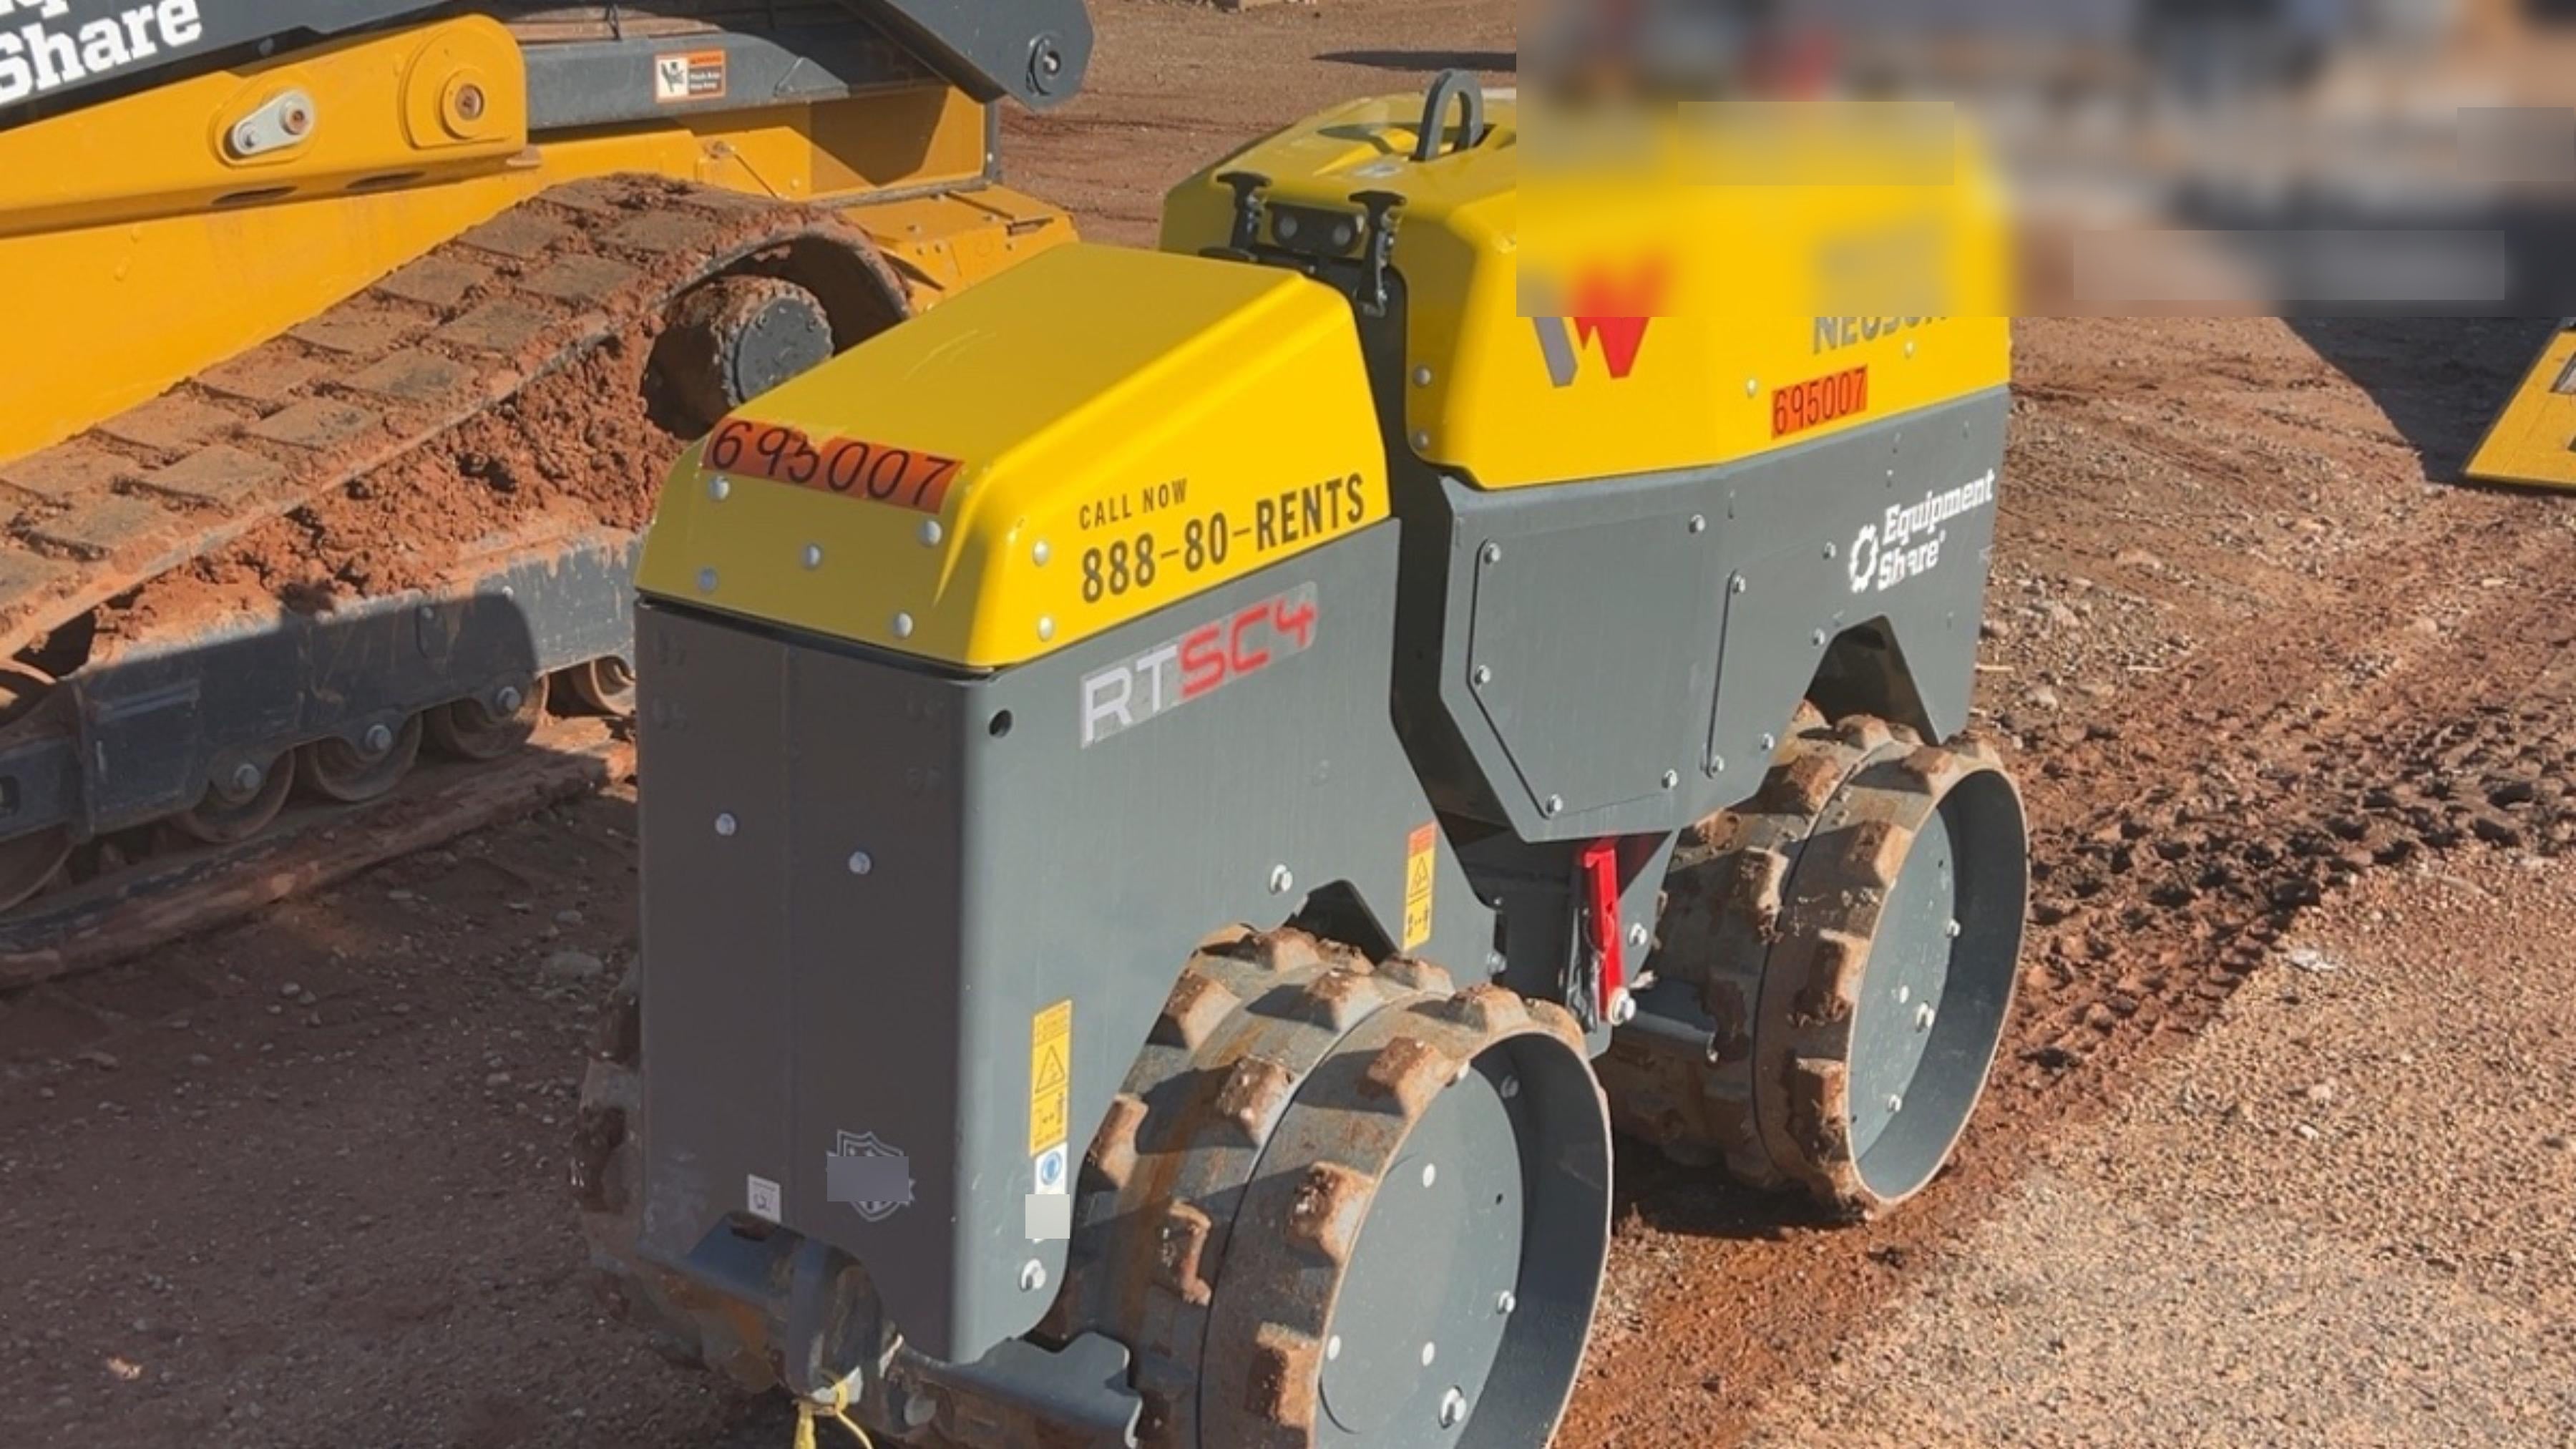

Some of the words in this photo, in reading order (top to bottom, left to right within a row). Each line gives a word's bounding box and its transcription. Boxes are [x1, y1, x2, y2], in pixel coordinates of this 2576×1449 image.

[1773, 367, 1865, 434] 695007
[712, 419, 955, 505] 695007
[1079, 494, 1133, 530] CALL
[1143, 477, 1188, 513] NOW
[1081, 472, 1365, 604] 888-80-RENTS
[1883, 468, 1995, 547] Equipment
[1878, 538, 1941, 592] Share
